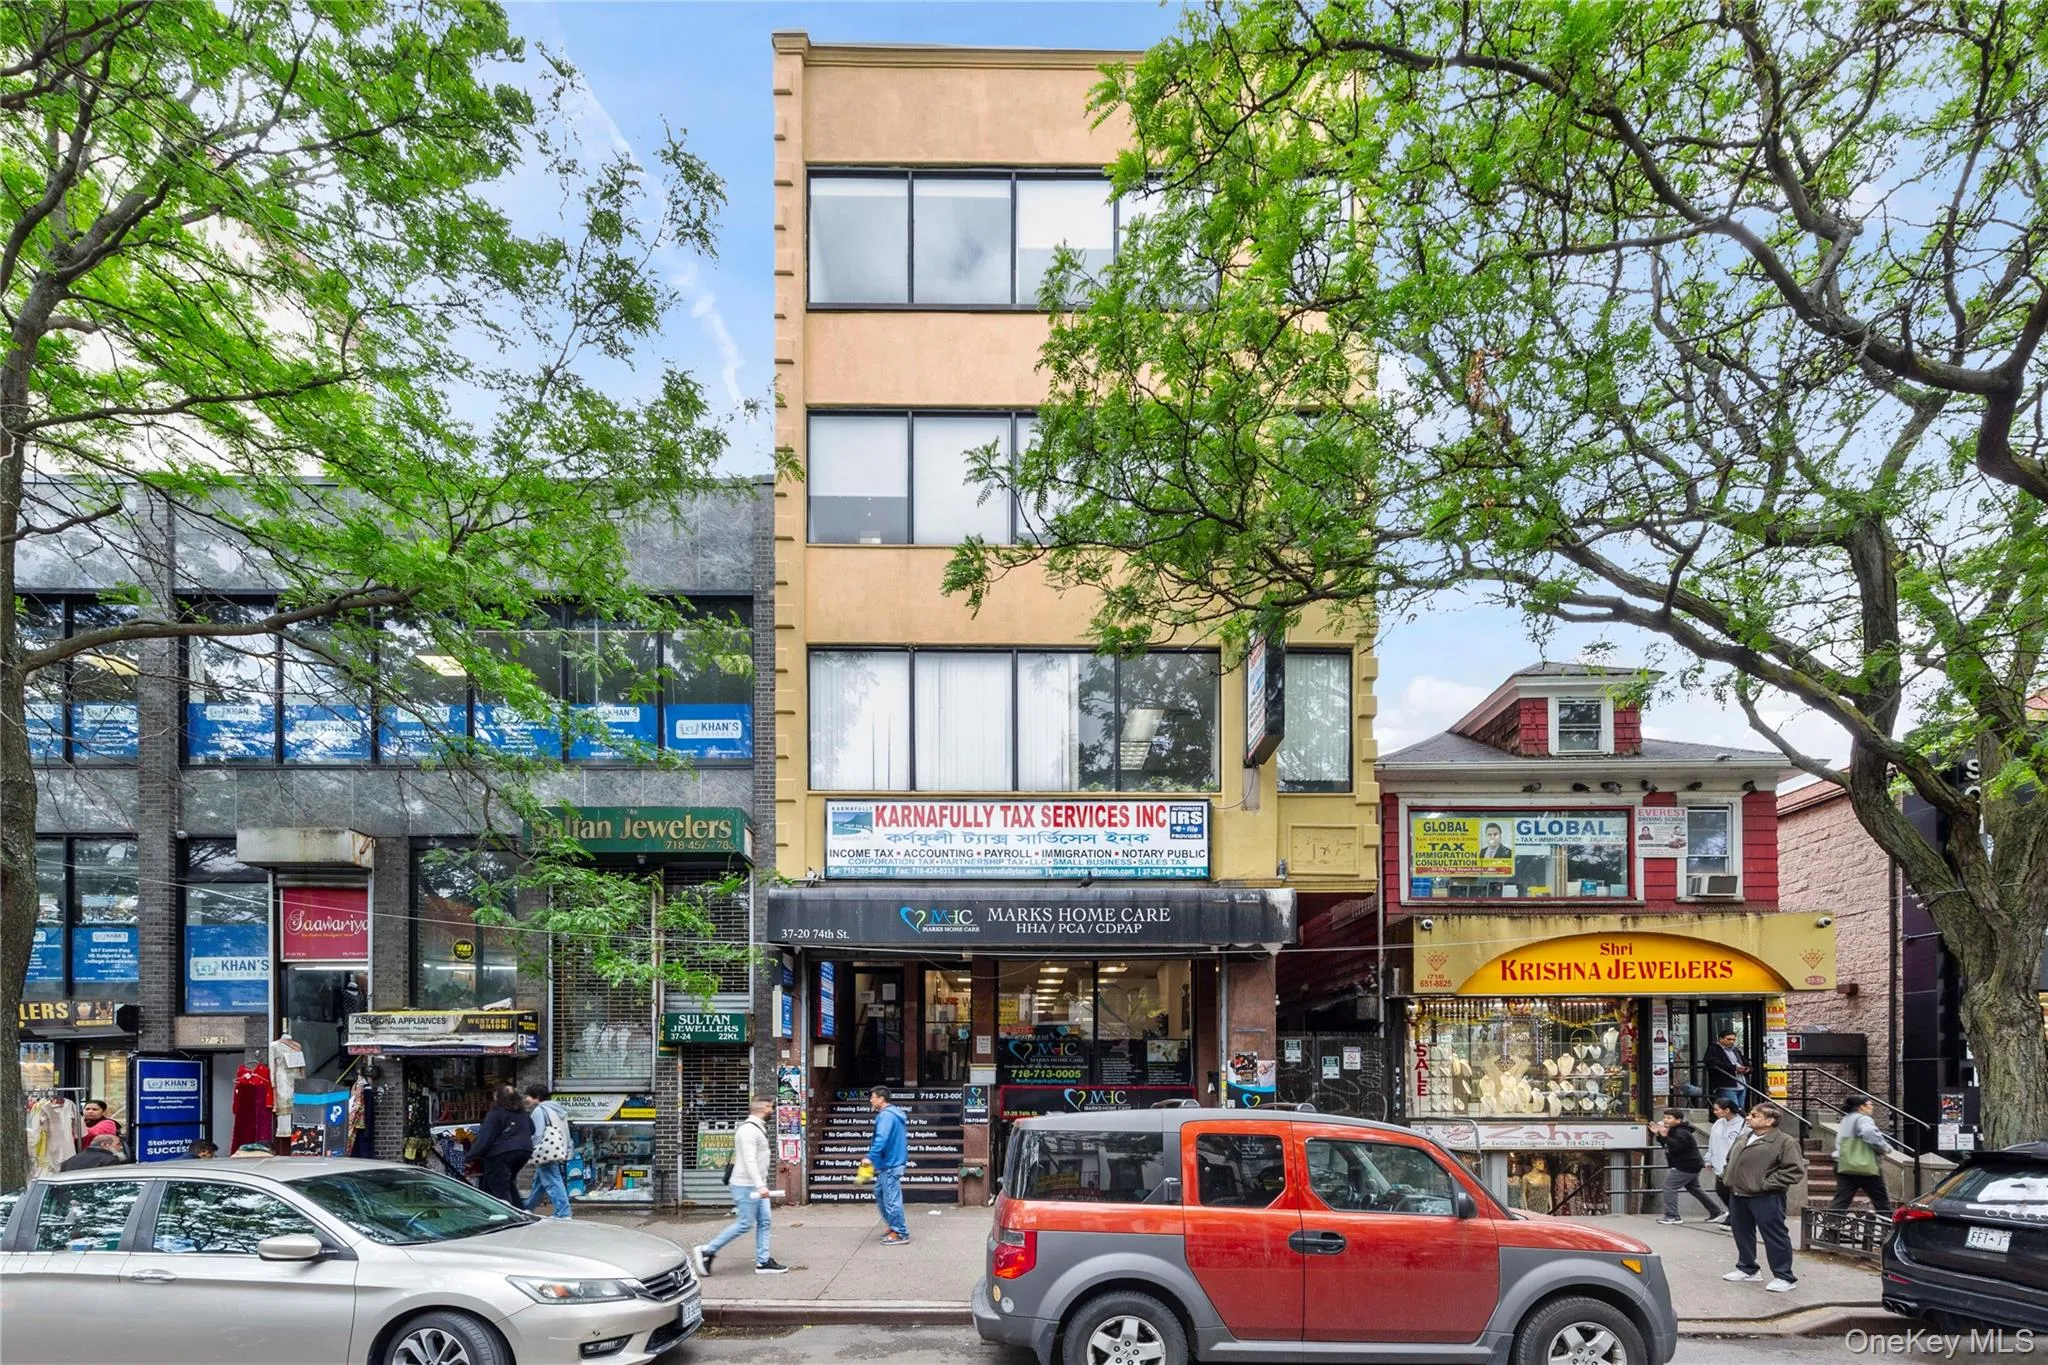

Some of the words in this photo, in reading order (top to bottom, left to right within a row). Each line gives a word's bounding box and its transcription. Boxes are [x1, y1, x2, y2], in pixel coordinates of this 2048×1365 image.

[701, 722, 740, 732] KHAN'S
[875, 805, 994, 828] KARNAFULLY
[1000, 805, 1035, 828] TAX
[1041, 805, 1130, 828] SERVICES
[1136, 805, 1167, 828] INC
[1638, 808, 1686, 816] EVEREST
[1171, 812, 1203, 824] IRS
[620, 813, 732, 840] Jewelers
[1423, 821, 1469, 832] GLOBAL
[1516, 820, 1611, 836] GLOBAL
[1427, 843, 1465, 851] TAX
[829, 849, 871, 858] INCOME
[873, 849, 894, 858] TAX
[903, 849, 974, 858] ACCOUNTING
[984, 849, 1032, 858] PAYROLL
[1041, 849, 1112, 858] IMMIGRATION
[1121, 849, 1164, 858] NOTARY
[1167, 849, 1206, 858] PUBLIC
[987, 908, 1053, 922] MARKS
[1058, 908, 1117, 922] HOME
[1120, 908, 1171, 922] CARE
[1016, 924, 1047, 933] HHA
[1058, 924, 1085, 933] PCA
[1096, 924, 1142, 933] CDPAP
[781, 929, 810, 939] 37-20
[813, 929, 834, 939] 74th
[836, 929, 850, 939] St.
[1600, 942, 1633, 956] Shri
[221, 959, 269, 972] KHAN'S
[1501, 959, 1602, 982] KRISHNA
[1607, 958, 1733, 980] JEWELERS
[1767, 1006, 1784, 1014] TAX
[398, 1017, 447, 1025] APPLIANCES
[678, 1014, 731, 1024] SULTAN
[718, 1033, 740, 1041] 22Kt.
[1011, 1069, 1082, 1078] 718-713-0005
[1414, 1044, 1428, 1097] SALE
[1768, 1075, 1786, 1085] TAX
[1486, 1124, 1613, 1141] Zahra
[147, 1139, 184, 1148] Stairway
[1519, 1140, 1546, 1148] Designer
[847, 1145, 869, 1153] Approved
